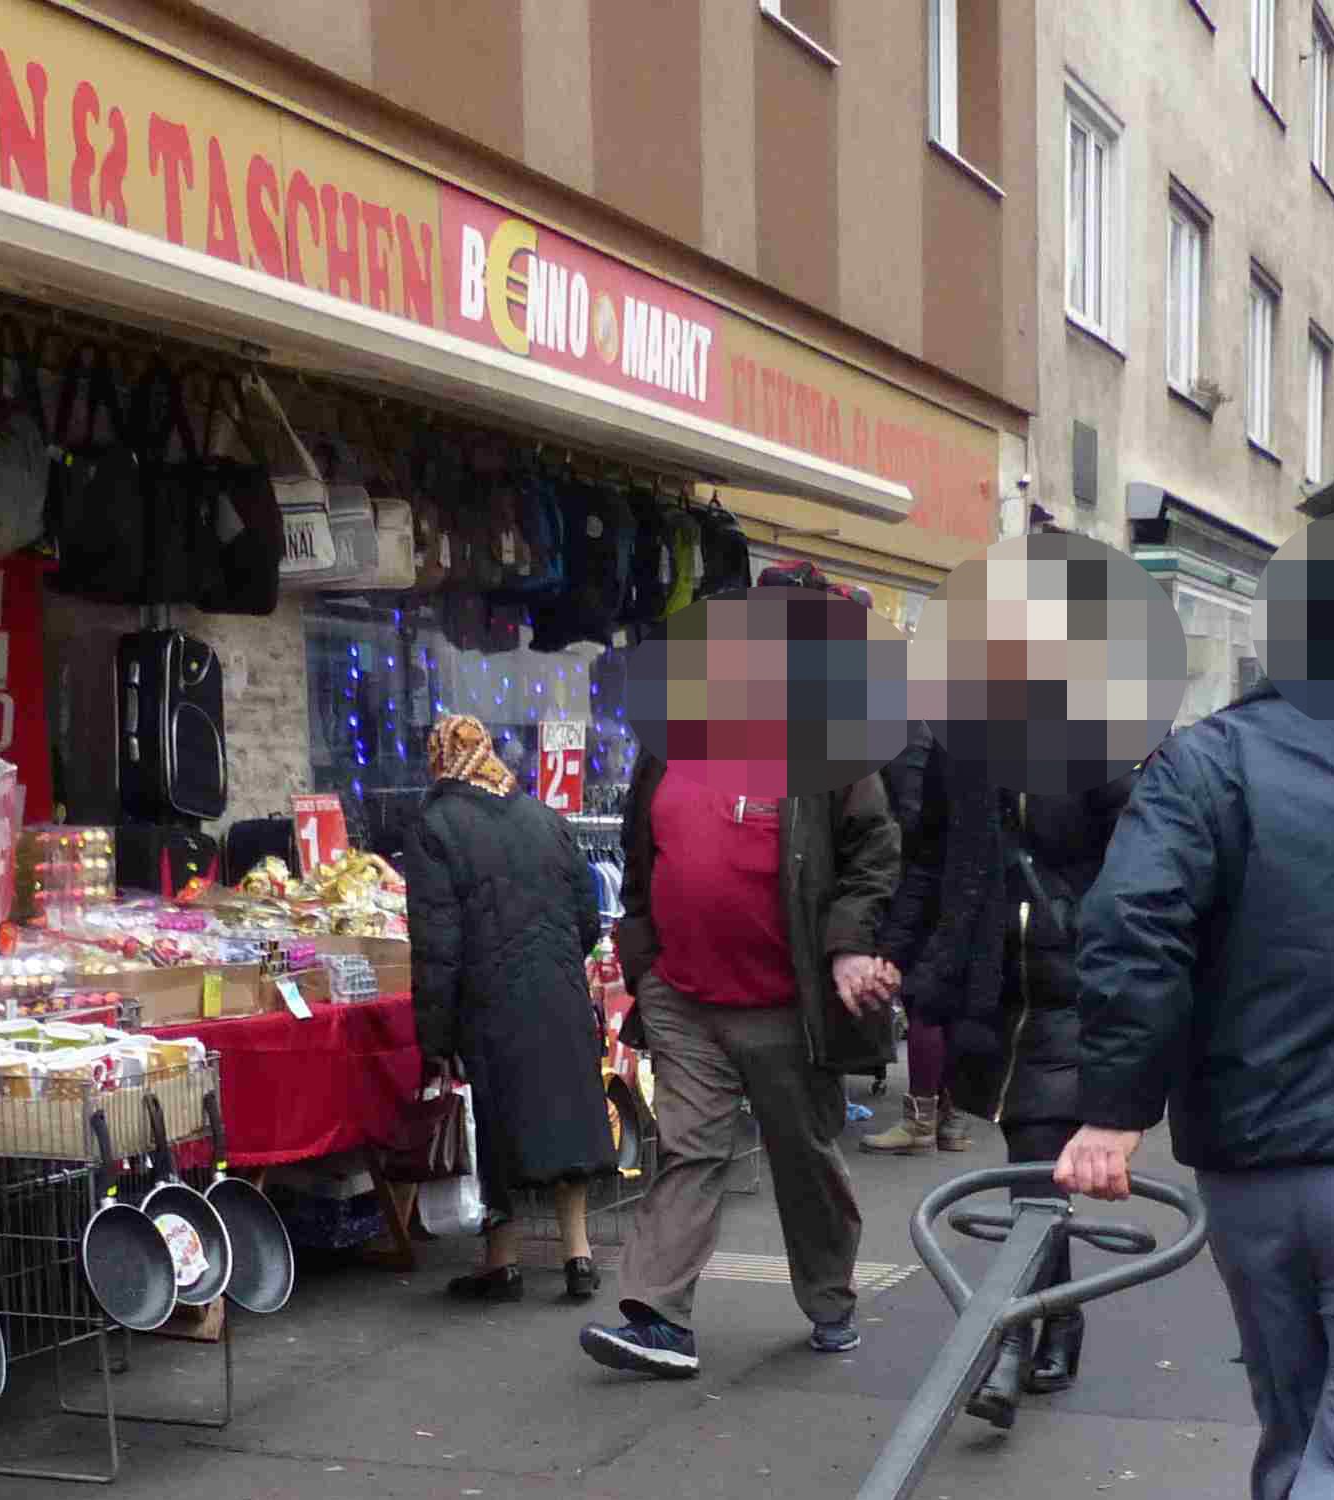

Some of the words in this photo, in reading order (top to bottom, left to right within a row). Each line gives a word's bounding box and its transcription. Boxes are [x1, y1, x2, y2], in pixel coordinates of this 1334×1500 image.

[71, 80, 129, 229] &
[148, 112, 435, 329] TASCHEN
[621, 295, 713, 403] MARKT
